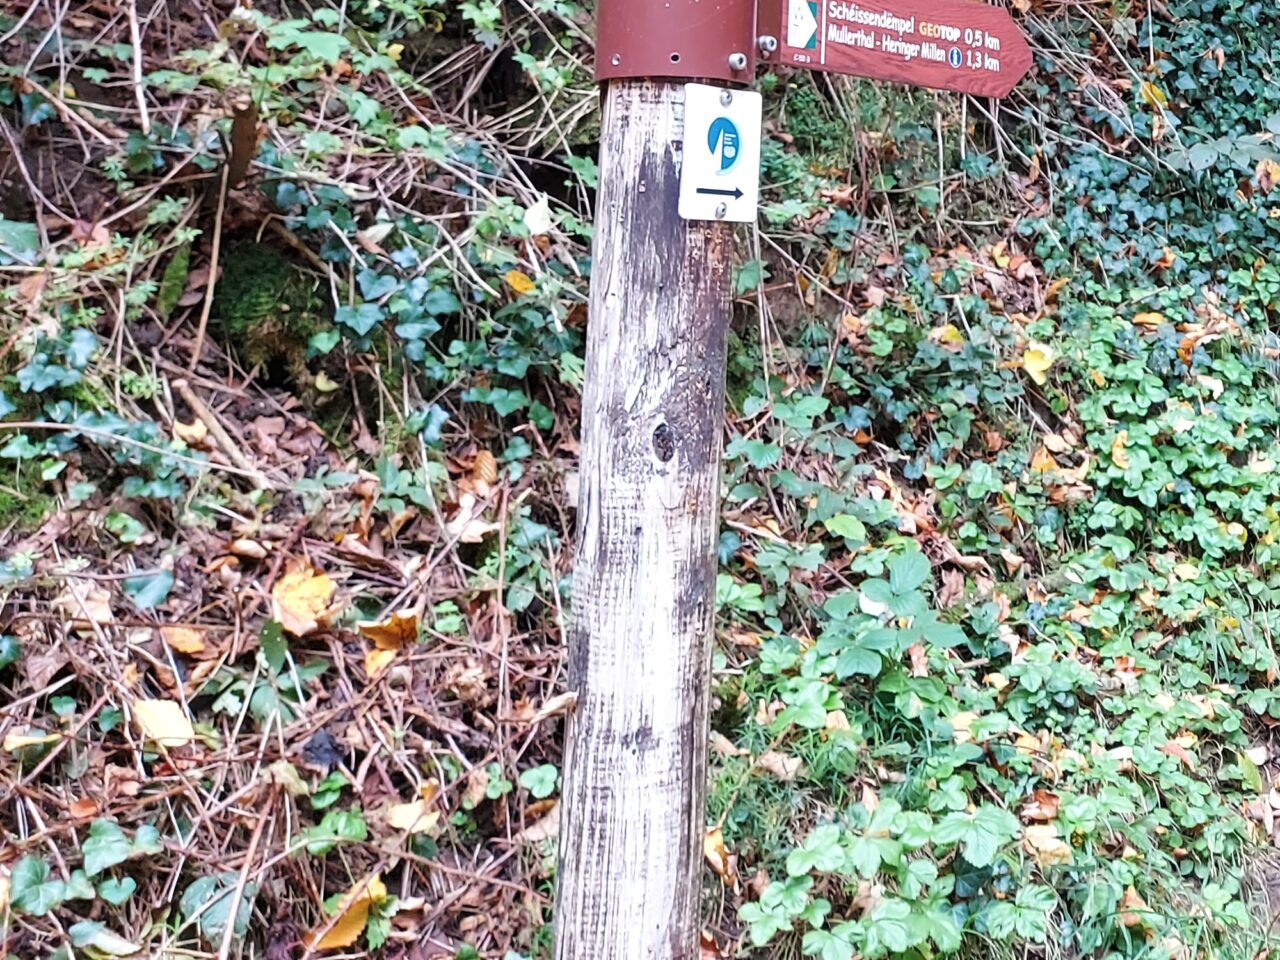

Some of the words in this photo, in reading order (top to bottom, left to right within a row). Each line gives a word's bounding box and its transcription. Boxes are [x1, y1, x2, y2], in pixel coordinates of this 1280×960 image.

[828, 25, 874, 48] Mullerthal
[882, 35, 920, 60] Heringer
[922, 45, 946, 62] Millen
[966, 51, 983, 70] 1,3
[984, 54, 999, 72] km
[829, 1, 914, 34] Schéissendëmpel
[919, 21, 960, 41] GEOTOP
[964, 28, 983, 47] 0,5
[984, 33, 1000, 51] km
